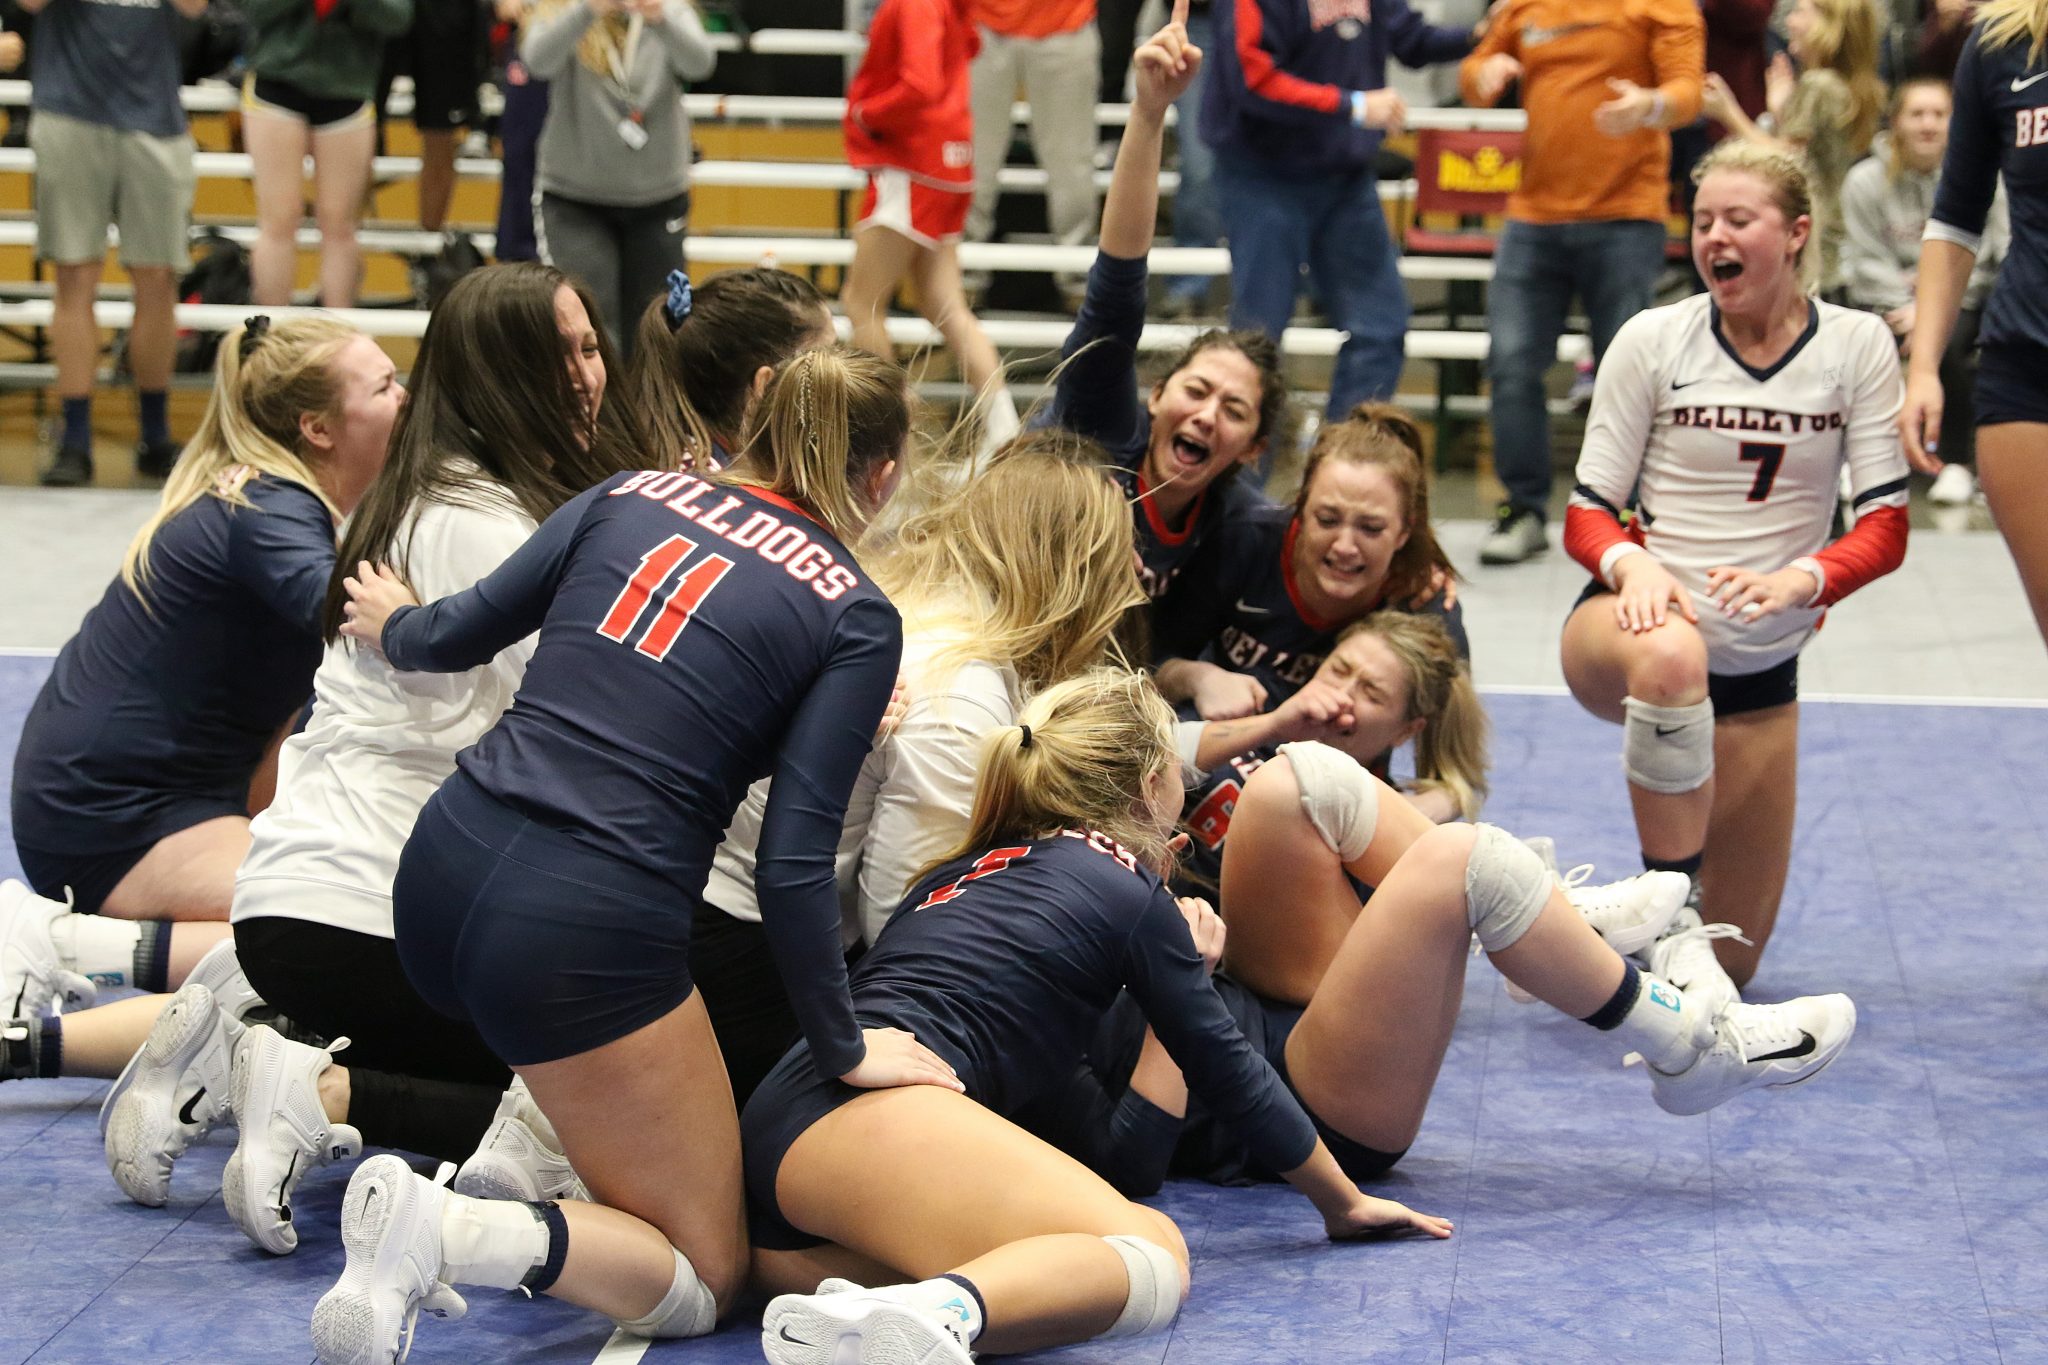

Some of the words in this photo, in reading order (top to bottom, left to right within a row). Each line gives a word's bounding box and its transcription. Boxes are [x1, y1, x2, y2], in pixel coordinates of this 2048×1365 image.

[608, 470, 858, 600] BULLDOGS
[1739, 441, 1787, 502] 7
[596, 533, 736, 663] 11
